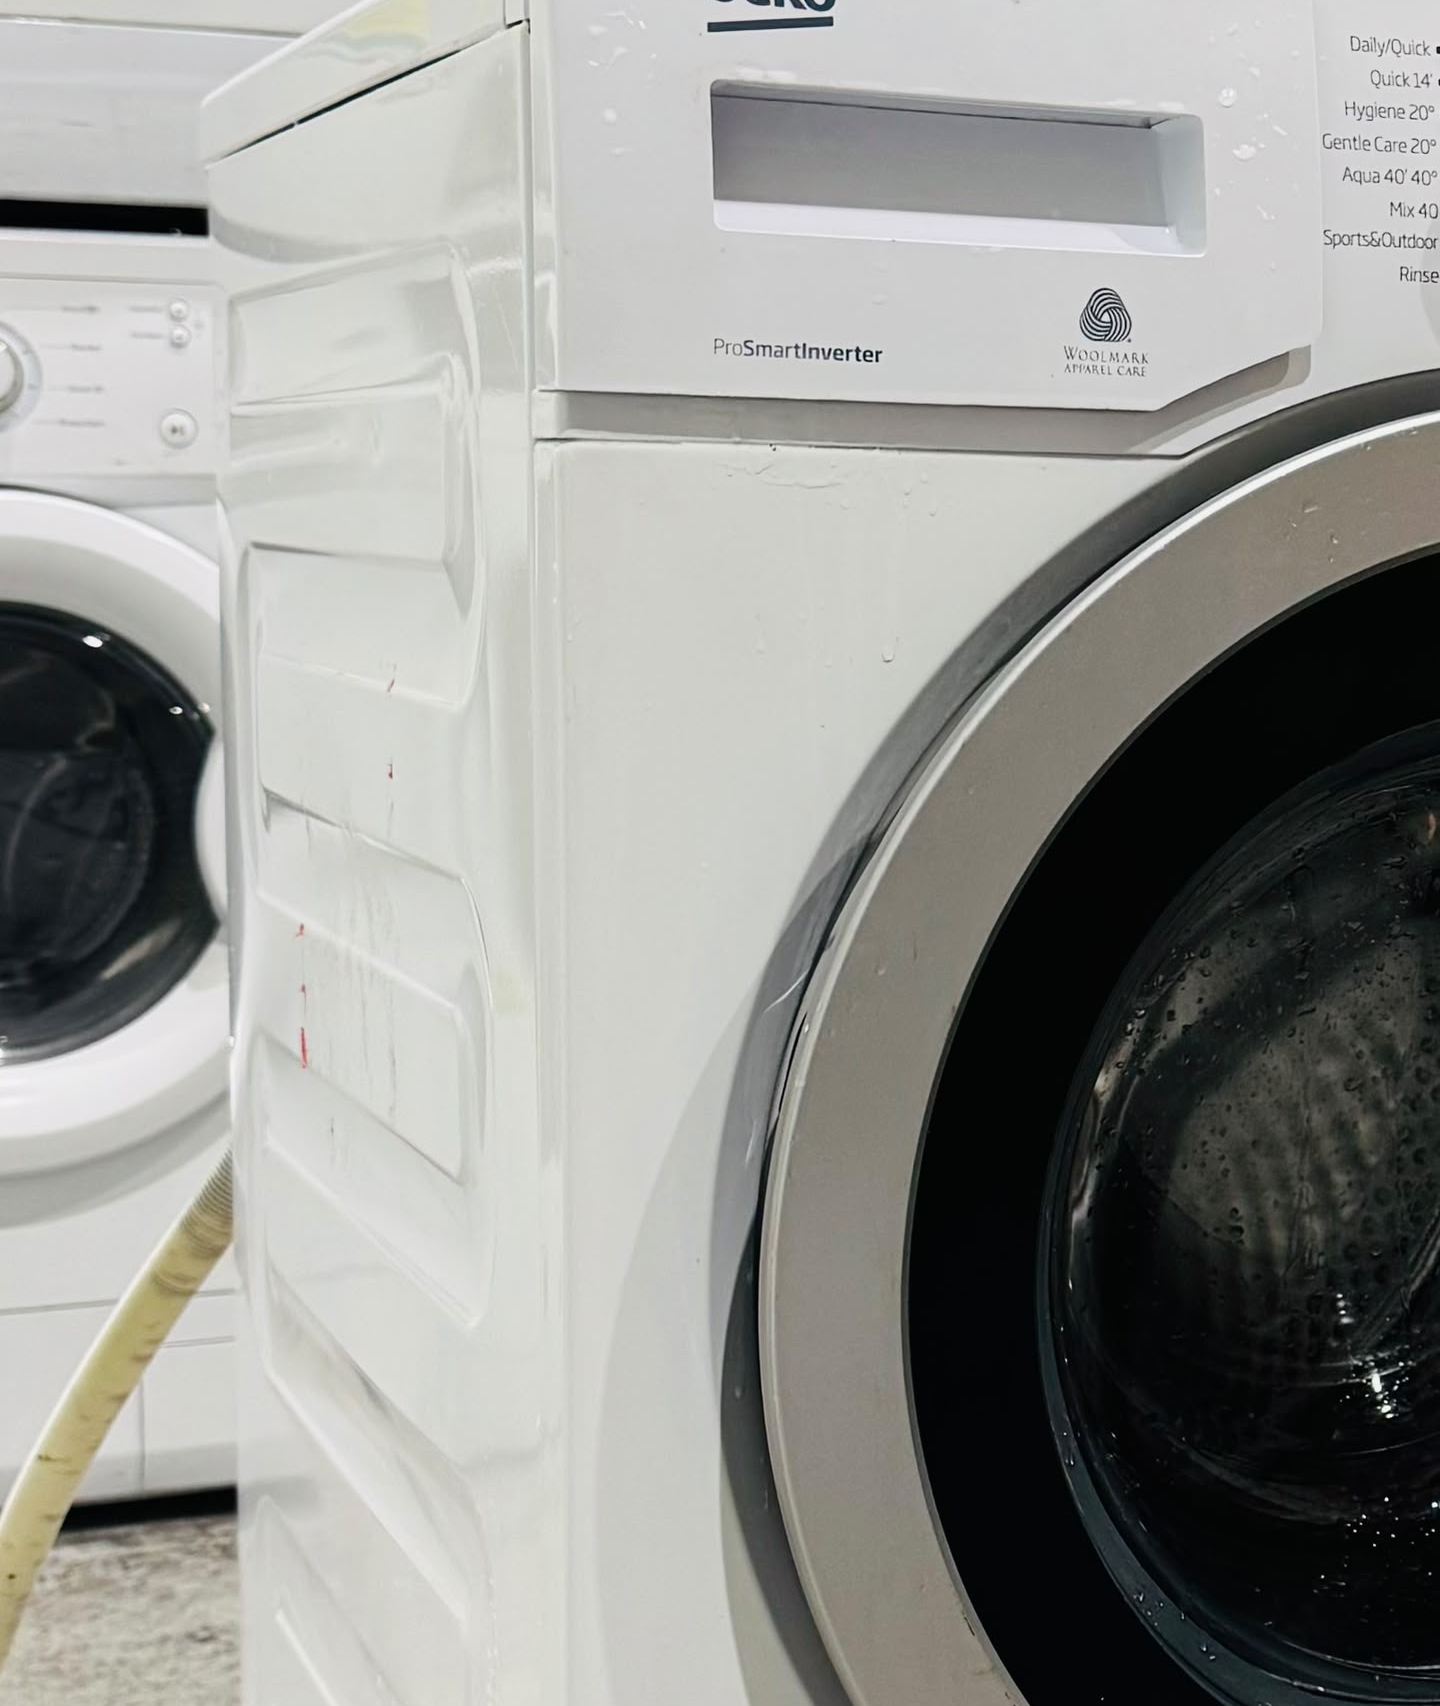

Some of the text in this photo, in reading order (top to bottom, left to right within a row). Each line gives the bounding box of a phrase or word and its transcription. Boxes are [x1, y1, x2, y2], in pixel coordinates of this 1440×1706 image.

[1350, 36, 1431, 57] Daily/Quick
[1370, 69, 1433, 89] Quick 14'
[1344, 101, 1405, 122] Hygiene
[1322, 133, 1371, 152] Gentle
[1374, 136, 1408, 153] Care
[1342, 166, 1380, 185] Aqua
[1384, 168, 1408, 185] 40'
[1389, 201, 1438, 219] Mix 40
[1323, 229, 1439, 250] Sports&Outdoor
[1399, 266, 1440, 283] Rinse
[713, 338, 883, 363] ProSmartInverter
[1063, 345, 1149, 364] WOOLMARK
[1064, 363, 1147, 377] APPAREL CARE
